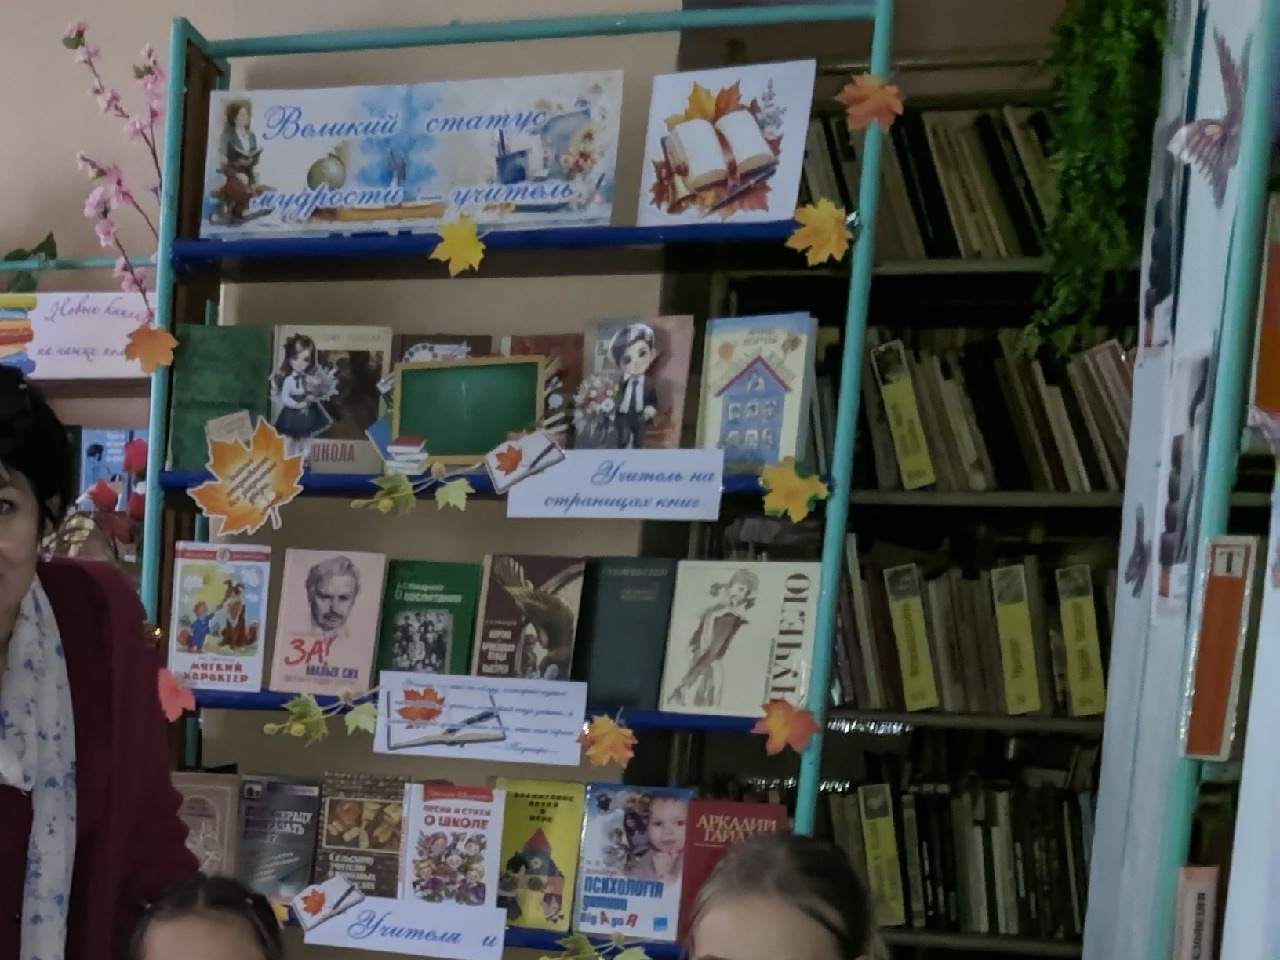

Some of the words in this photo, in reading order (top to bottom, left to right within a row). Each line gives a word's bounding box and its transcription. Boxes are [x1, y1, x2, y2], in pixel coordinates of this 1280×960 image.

[262, 105, 400, 140] Великий
[425, 110, 548, 135] статус
[251, 186, 403, 218] мудрости
[591, 460, 683, 485] Учитель
[689, 470, 715, 483] на
[544, 492, 650, 513] страницах
[424, 815, 436, 826] О
[438, 816, 489, 829] ШКОЛЕ
[346, 909, 463, 944] Учителя
[481, 934, 498, 948] и
